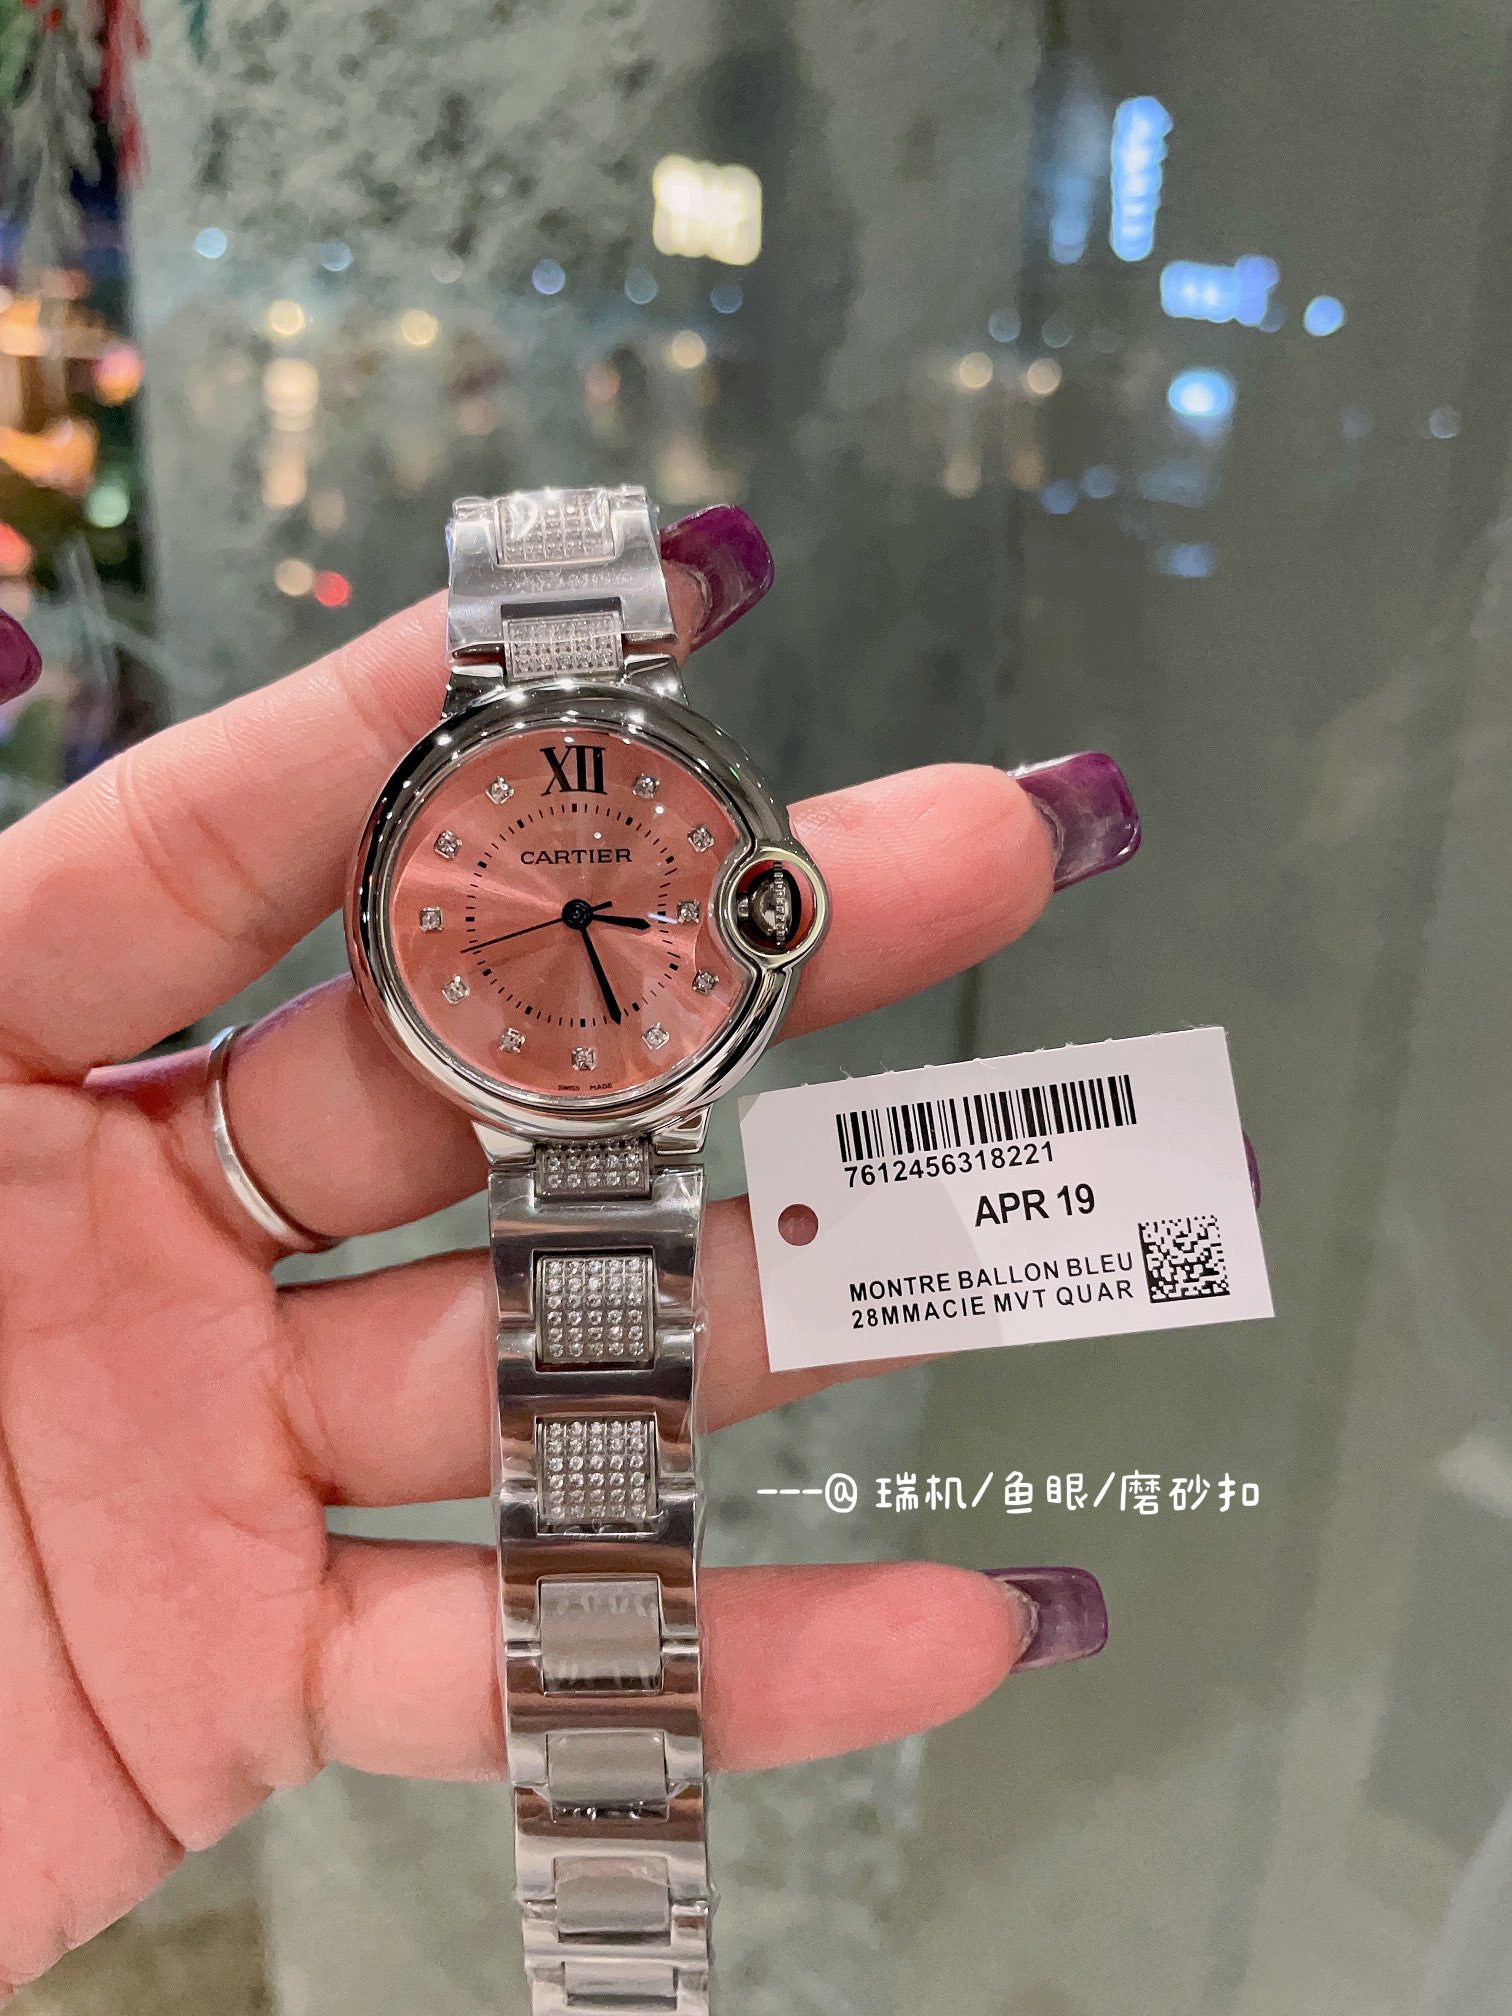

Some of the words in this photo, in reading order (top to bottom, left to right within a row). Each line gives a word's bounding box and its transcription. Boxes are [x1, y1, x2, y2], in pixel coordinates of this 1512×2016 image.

[539, 745, 608, 796] XII
[520, 848, 633, 865] CARTIER
[589, 1082, 613, 1091] MADE
[844, 1140, 1054, 1188] 7612456318221
[974, 1189, 1050, 1228] APR
[1055, 1183, 1096, 1216] 19
[849, 1272, 952, 1303] MONTRE
[957, 1262, 1060, 1290] BALLON
[1066, 1251, 1134, 1277] BLEU
[851, 1298, 987, 1330] 28MMACIE
[993, 1288, 1046, 1313] MVT
[1056, 1279, 1135, 1306] QUAR
